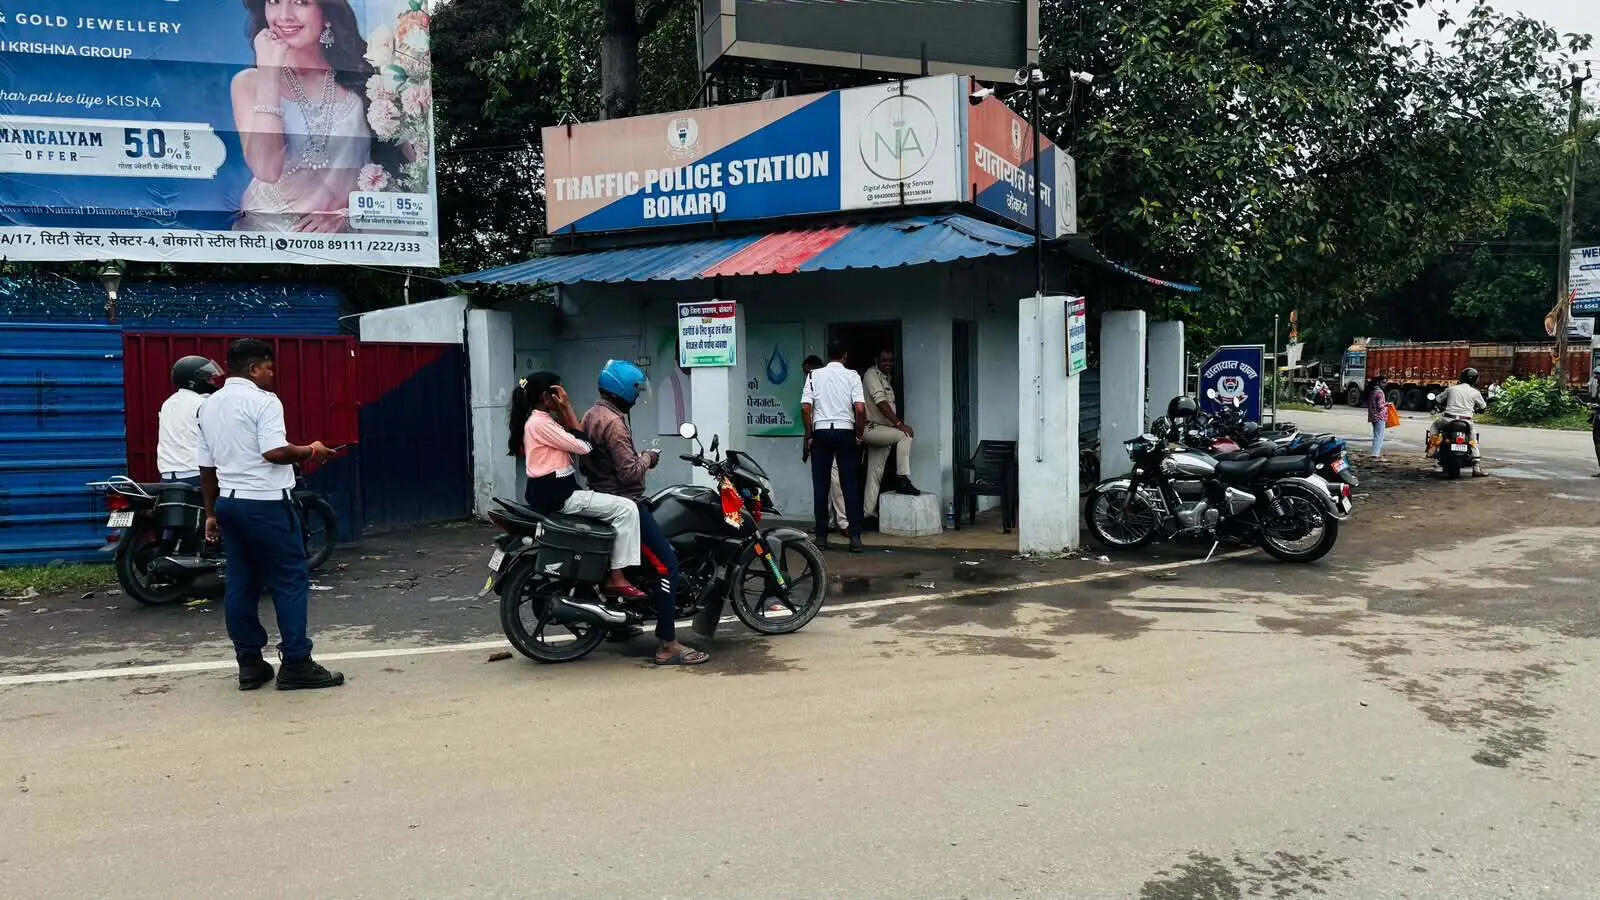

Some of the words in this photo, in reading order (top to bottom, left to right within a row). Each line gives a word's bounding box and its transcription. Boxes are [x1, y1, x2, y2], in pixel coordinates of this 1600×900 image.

[16, 13, 67, 27] GOLD
[77, 17, 181, 34] JEWELLERY
[9, 41, 76, 56] KRISHNA
[80, 46, 132, 58] GROUP
[28, 92, 55, 105] pal
[55, 92, 75, 103] ke
[76, 93, 104, 108] liye
[106, 95, 161, 108] KISNA
[0, 129, 103, 146] MANGALYAM
[124, 128, 182, 159] 50%
[25, 150, 77, 161] OFFER
[553, 171, 639, 201] TRAFFIC
[644, 162, 722, 194] POLICE
[728, 150, 829, 186] STATION
[973, 141, 1026, 192] यातायात
[1028, 174, 1051, 208] थना
[45, 205, 83, 215] Natural
[87, 206, 133, 216] Diamond
[133, 207, 178, 219] Jewellery
[643, 191, 726, 219] BOKARO
[40, 231, 69, 245] सिटी
[73, 232, 104, 247] सेंटर,
[108, 232, 159, 247] सेक्टर-4,
[162, 232, 204, 247] बोकारो
[207, 234, 236, 248] स्टील
[239, 235, 266, 248] सिटी
[288, 239, 324, 250] 70708
[328, 240, 363, 250] 89111
[367, 241, 421, 252] /222/333
[1582, 247, 1600, 258] WE
[1204, 360, 1239, 379] यातायात
[1239, 362, 1258, 380] थाना
